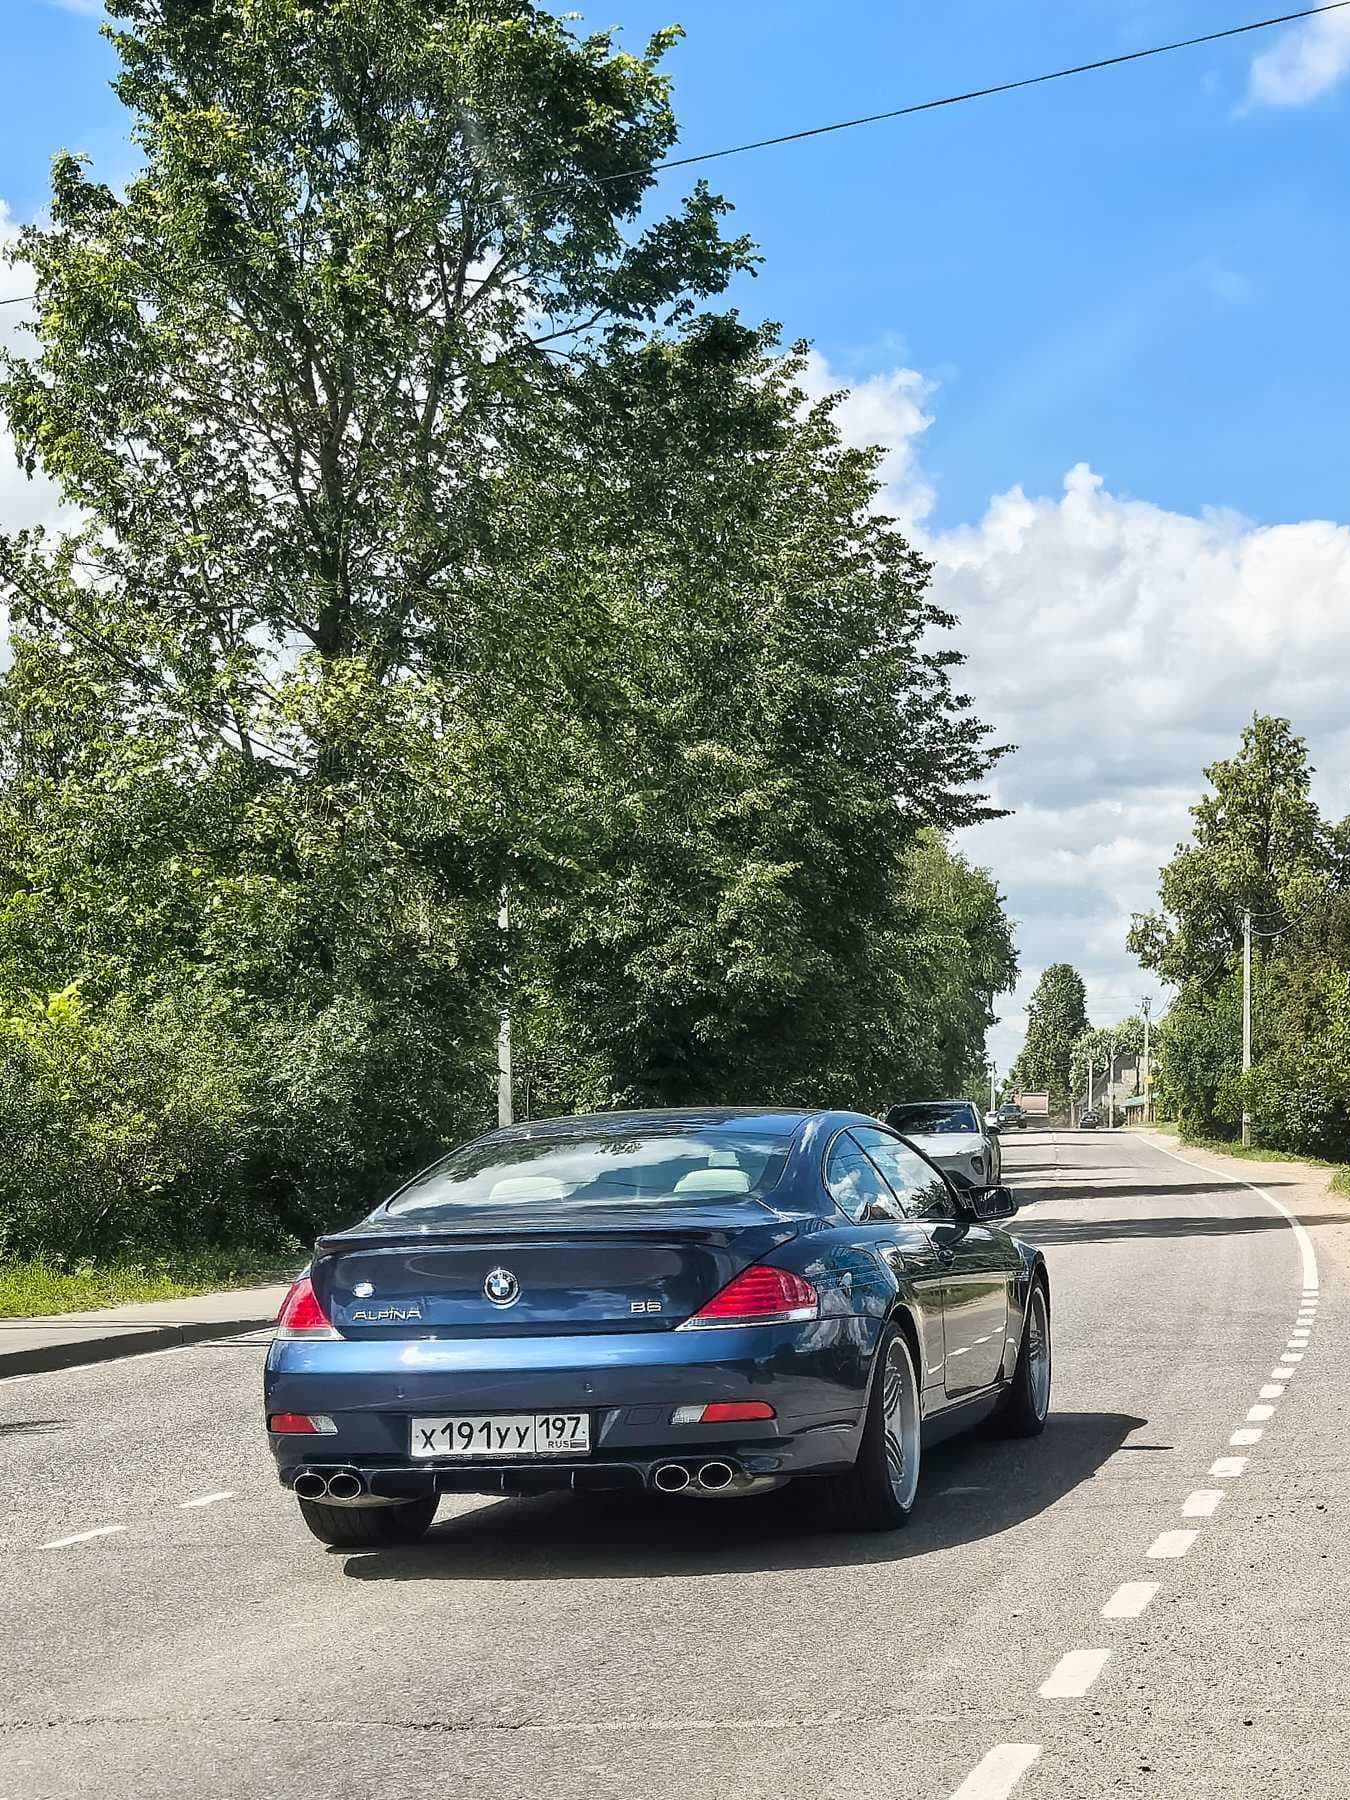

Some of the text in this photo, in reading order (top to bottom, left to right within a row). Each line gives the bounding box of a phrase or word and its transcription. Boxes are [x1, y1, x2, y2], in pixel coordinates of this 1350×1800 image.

[631, 1301, 662, 1313] B6
[538, 1416, 581, 1439] 197
[547, 1440, 570, 1449] RUS
